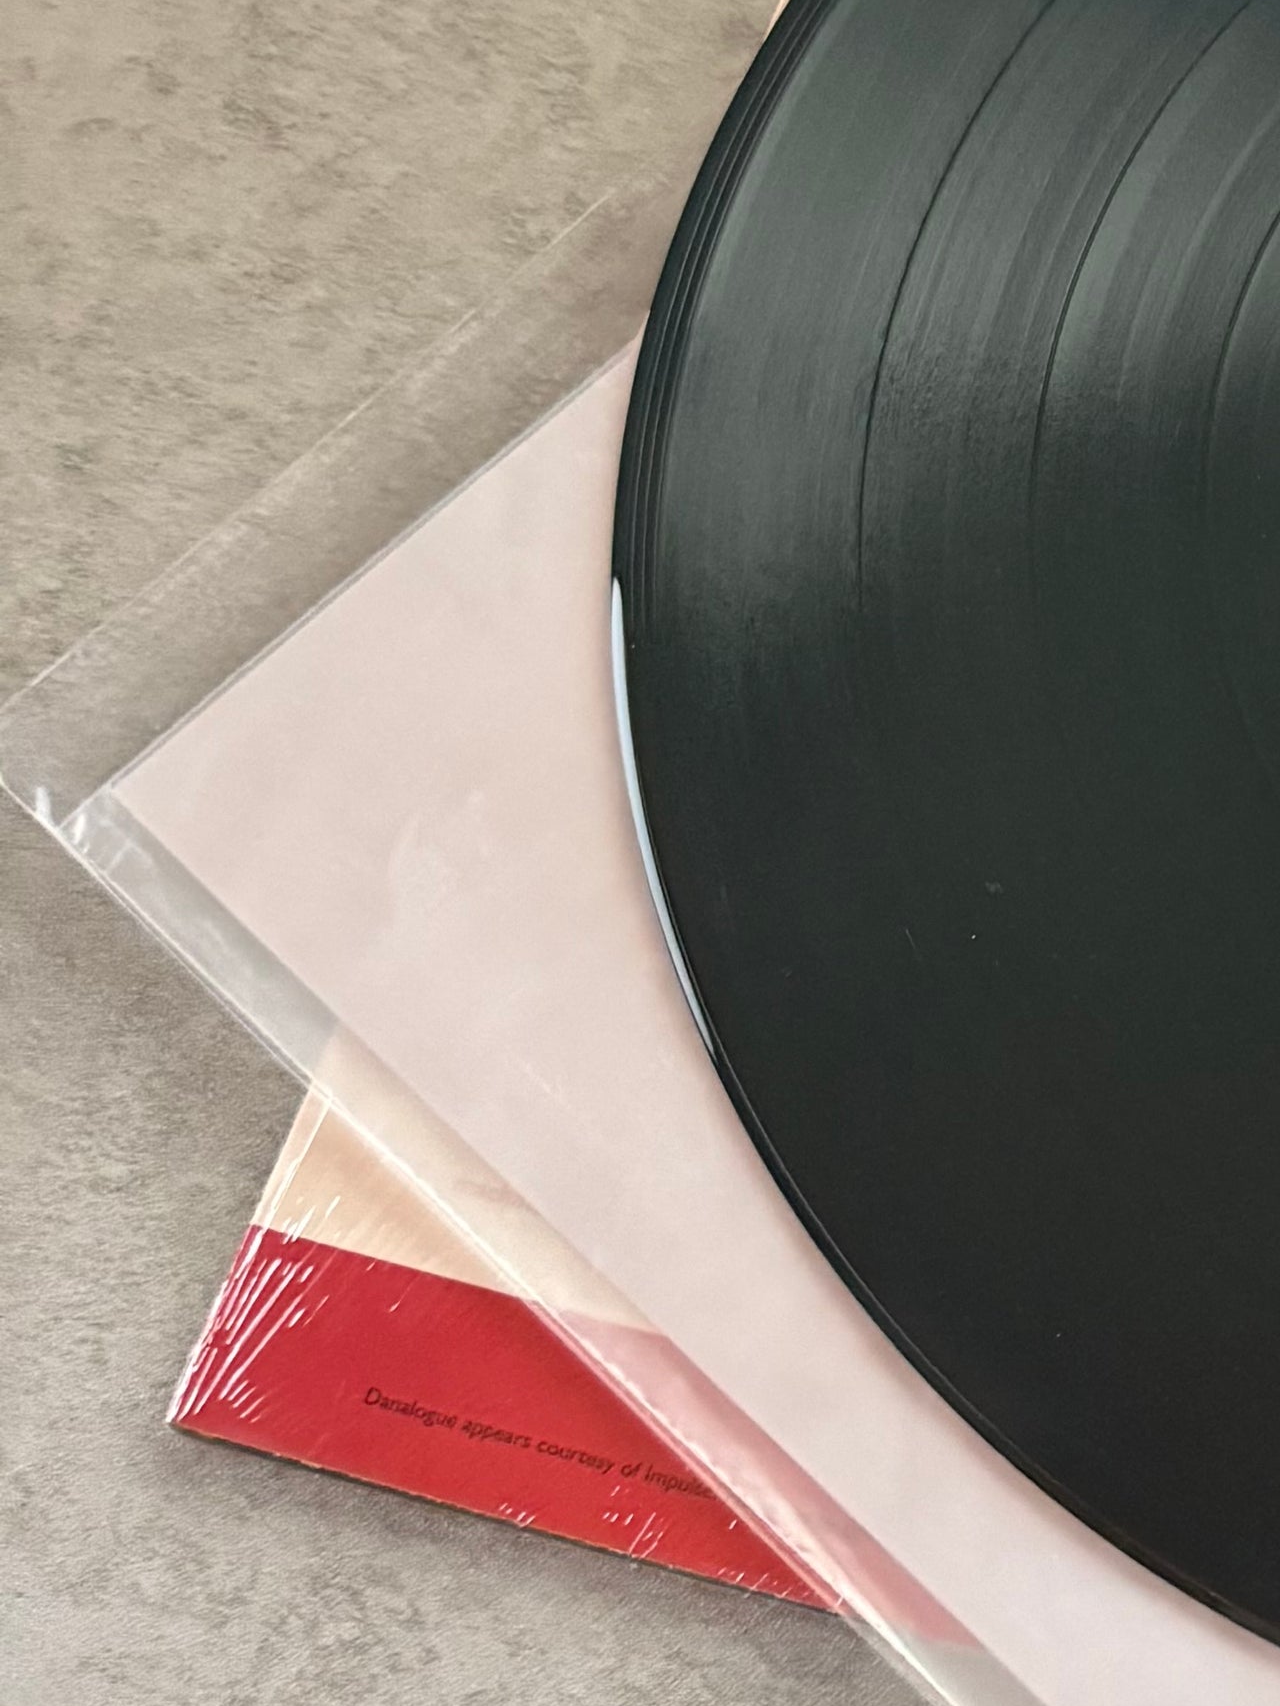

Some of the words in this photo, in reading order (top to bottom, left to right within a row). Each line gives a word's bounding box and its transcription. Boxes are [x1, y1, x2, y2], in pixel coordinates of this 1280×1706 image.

[364, 1386, 457, 1429] Danalogue
[462, 1421, 531, 1448] appears
[537, 1441, 615, 1475] courtesy
[621, 1462, 643, 1477] of
